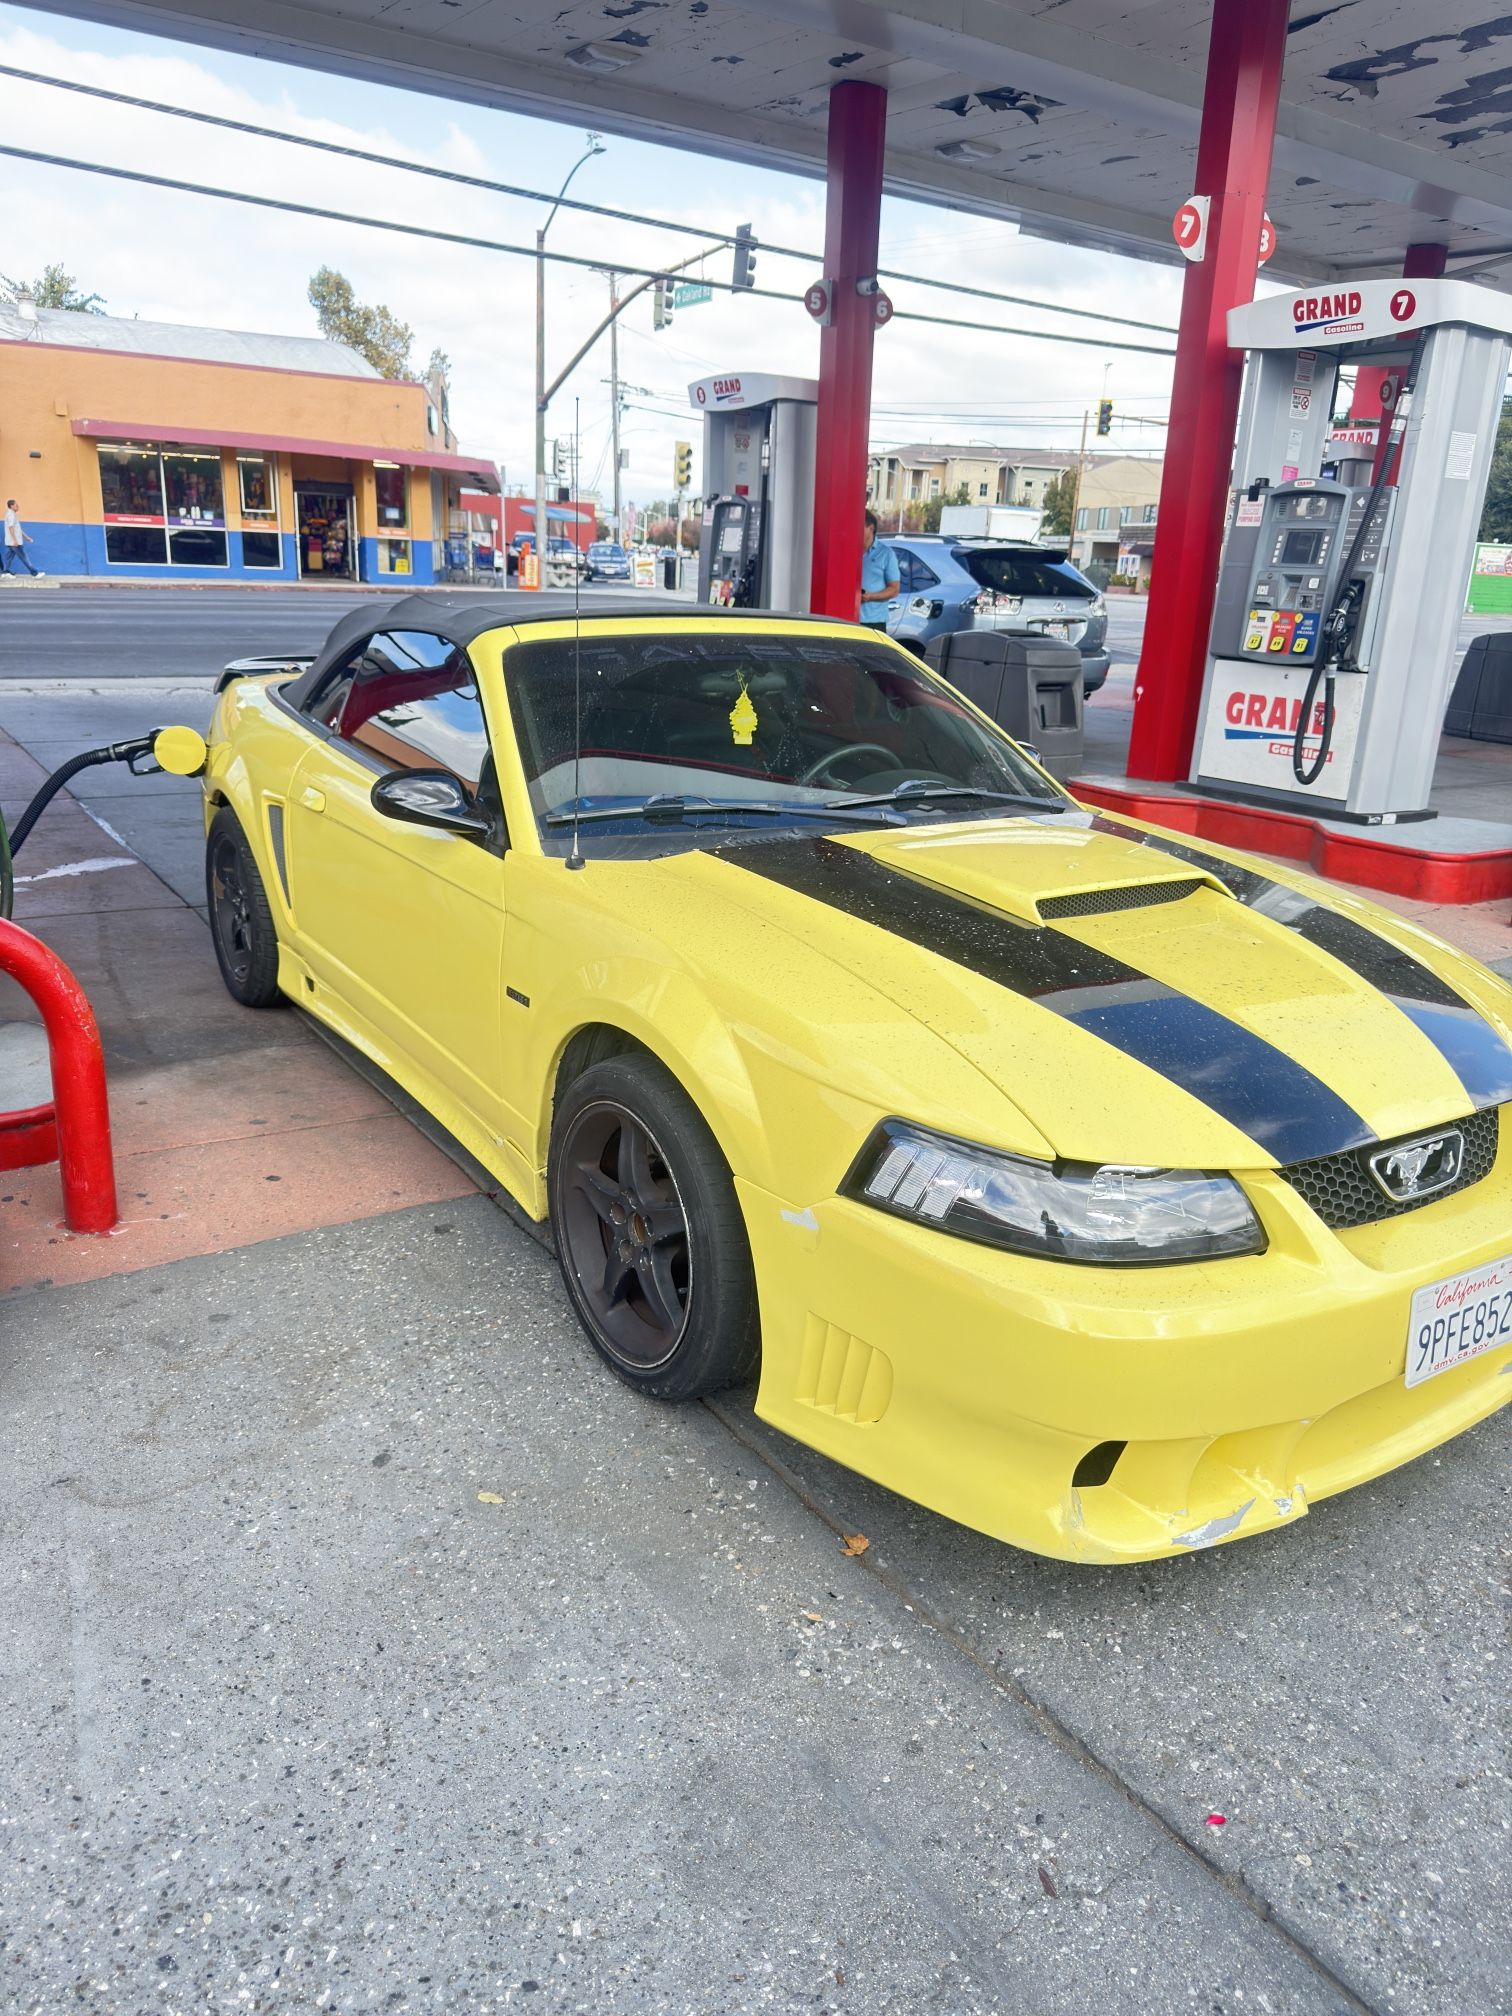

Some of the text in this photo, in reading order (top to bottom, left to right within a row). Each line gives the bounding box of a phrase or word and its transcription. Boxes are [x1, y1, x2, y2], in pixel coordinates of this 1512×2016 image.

[1180, 214, 1195, 238] 7
[682, 287, 702, 303] Oakland
[810, 292, 821, 310] 5
[876, 300, 888, 318] 6
[1293, 292, 1408, 322] GRAND 7
[1325, 323, 1363, 334] Gasoline
[713, 379, 741, 395] GRAND
[1382, 384, 1390, 397] 9
[1436, 1271, 1504, 1309] California
[1416, 1290, 1512, 1372] 9PFE852
[1433, 1341, 1490, 1371] dmv.ca.gov
